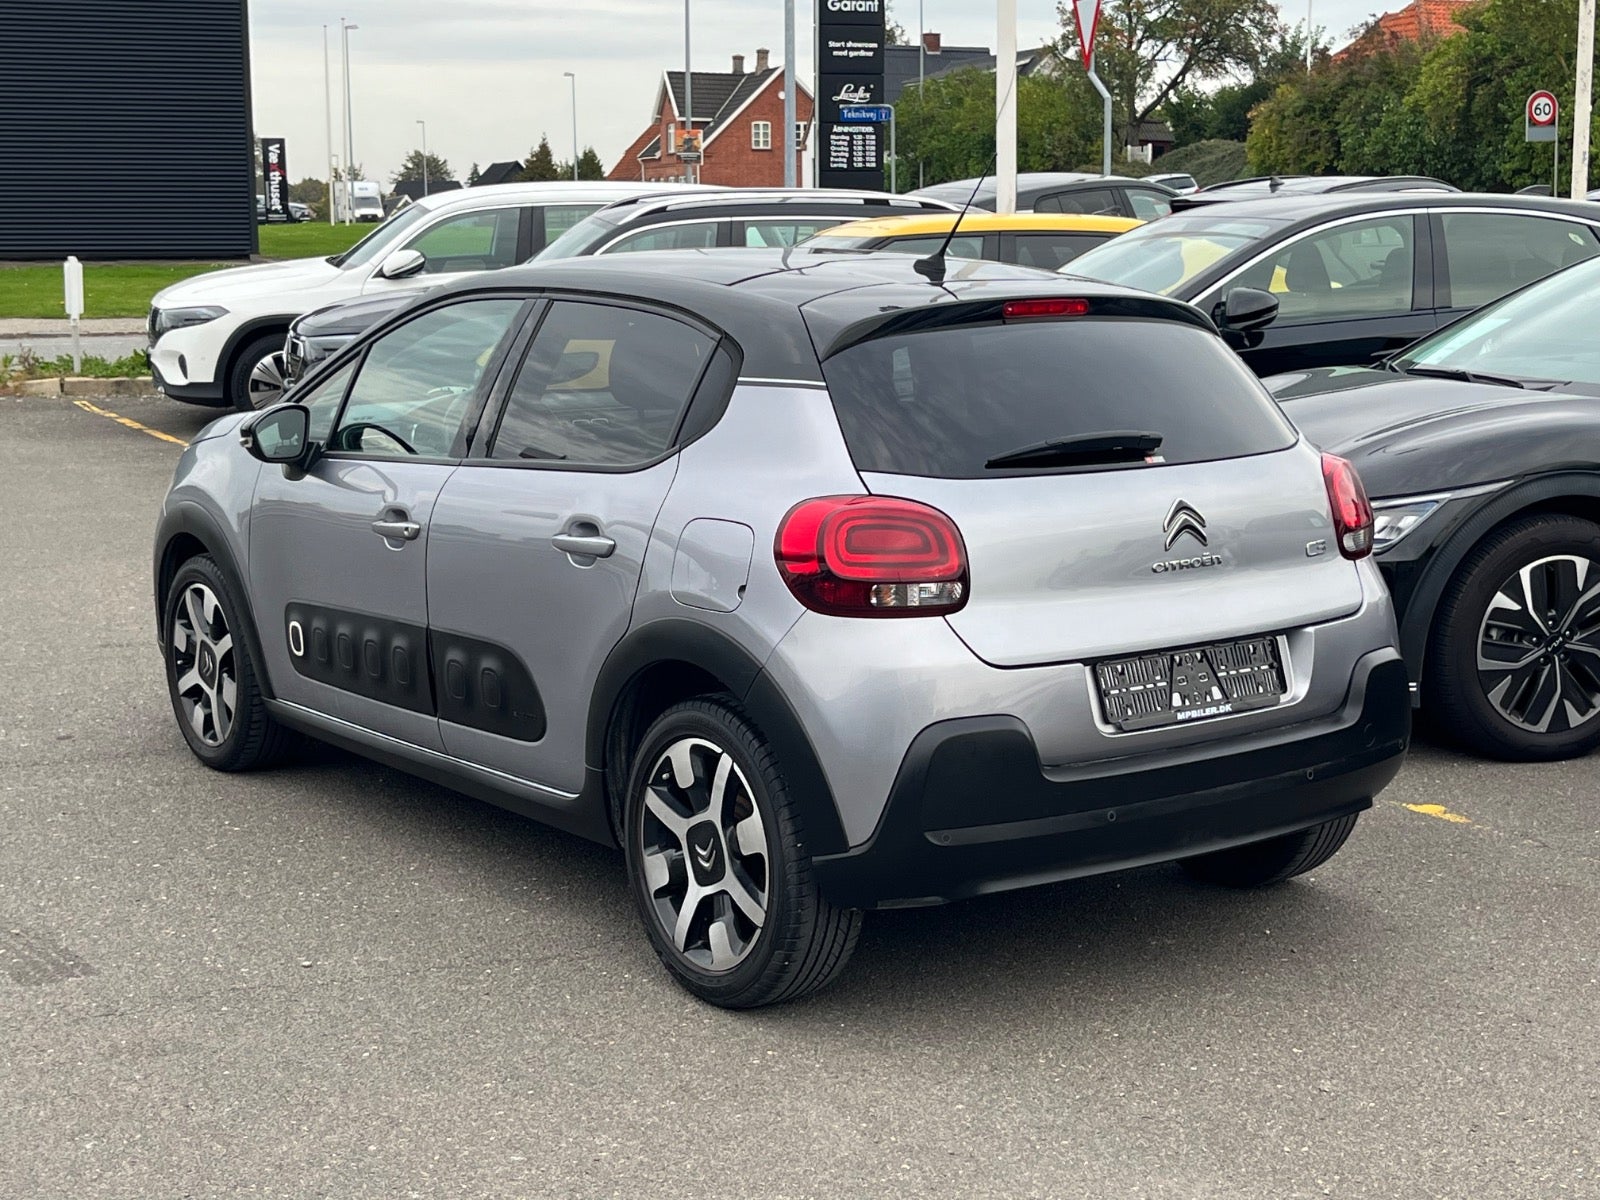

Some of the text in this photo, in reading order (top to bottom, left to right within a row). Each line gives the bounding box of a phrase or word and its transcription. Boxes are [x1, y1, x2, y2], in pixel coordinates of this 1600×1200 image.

[827, 0, 879, 12] Garant
[842, 109, 877, 121] Teknikvej
[1534, 103, 1551, 116] 60
[1151, 552, 1222, 574] CITROËN
[1176, 703, 1233, 721] MPBILER.DK
